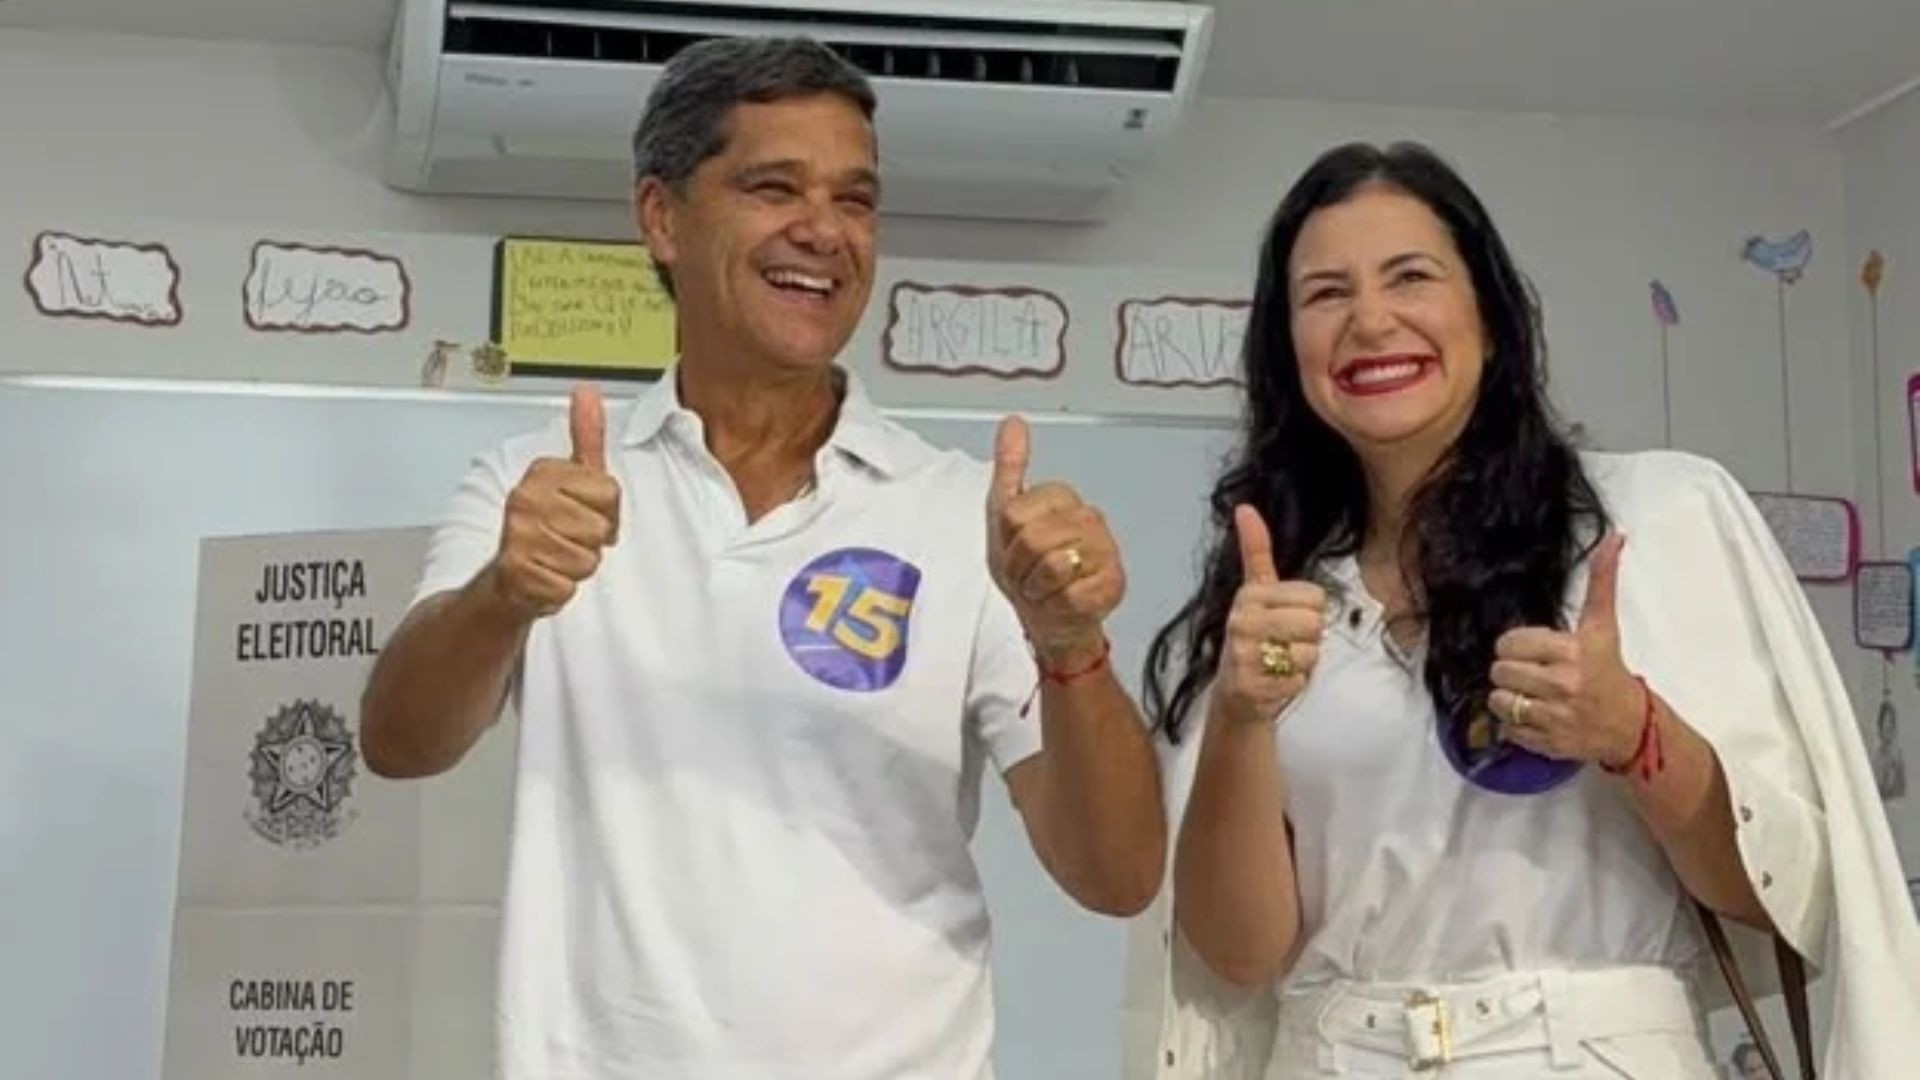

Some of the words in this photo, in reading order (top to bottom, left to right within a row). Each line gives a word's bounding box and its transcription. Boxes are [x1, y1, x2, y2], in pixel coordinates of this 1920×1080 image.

[255, 559, 366, 609] JUSTIÇA
[805, 573, 912, 661] 15
[236, 619, 379, 662] ELEITORAL
[229, 980, 316, 1011] CABINA
[322, 981, 354, 1011] DE
[235, 1022, 342, 1065] VOTAÇÃO
